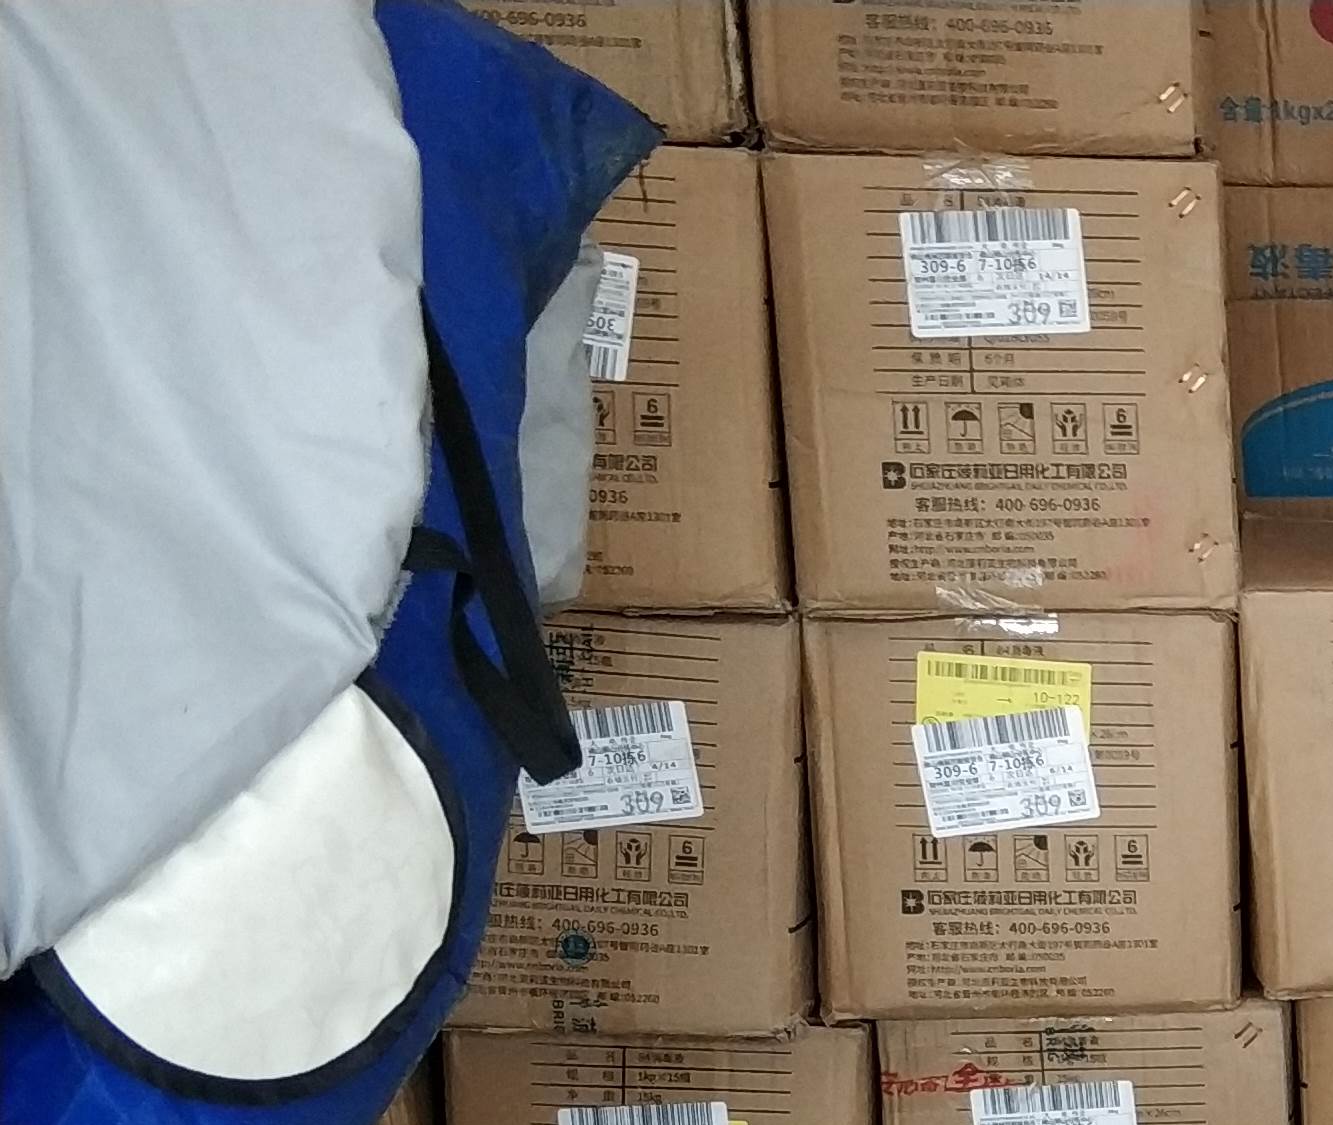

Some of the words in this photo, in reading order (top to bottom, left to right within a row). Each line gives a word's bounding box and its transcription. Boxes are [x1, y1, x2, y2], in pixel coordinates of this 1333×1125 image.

[946, 18, 1053, 36] 400-696-0936
[920, 260, 966, 274] 309-6
[995, 497, 1101, 512] 400-696-0936
[651, 760, 677, 770] 4/14
[934, 761, 979, 780] 309-6
[619, 789, 665, 815] 309
[1019, 794, 1062, 818] 309
[552, 918, 659, 937] 400-696-0936
[1008, 921, 1111, 936] 400-696-0936
